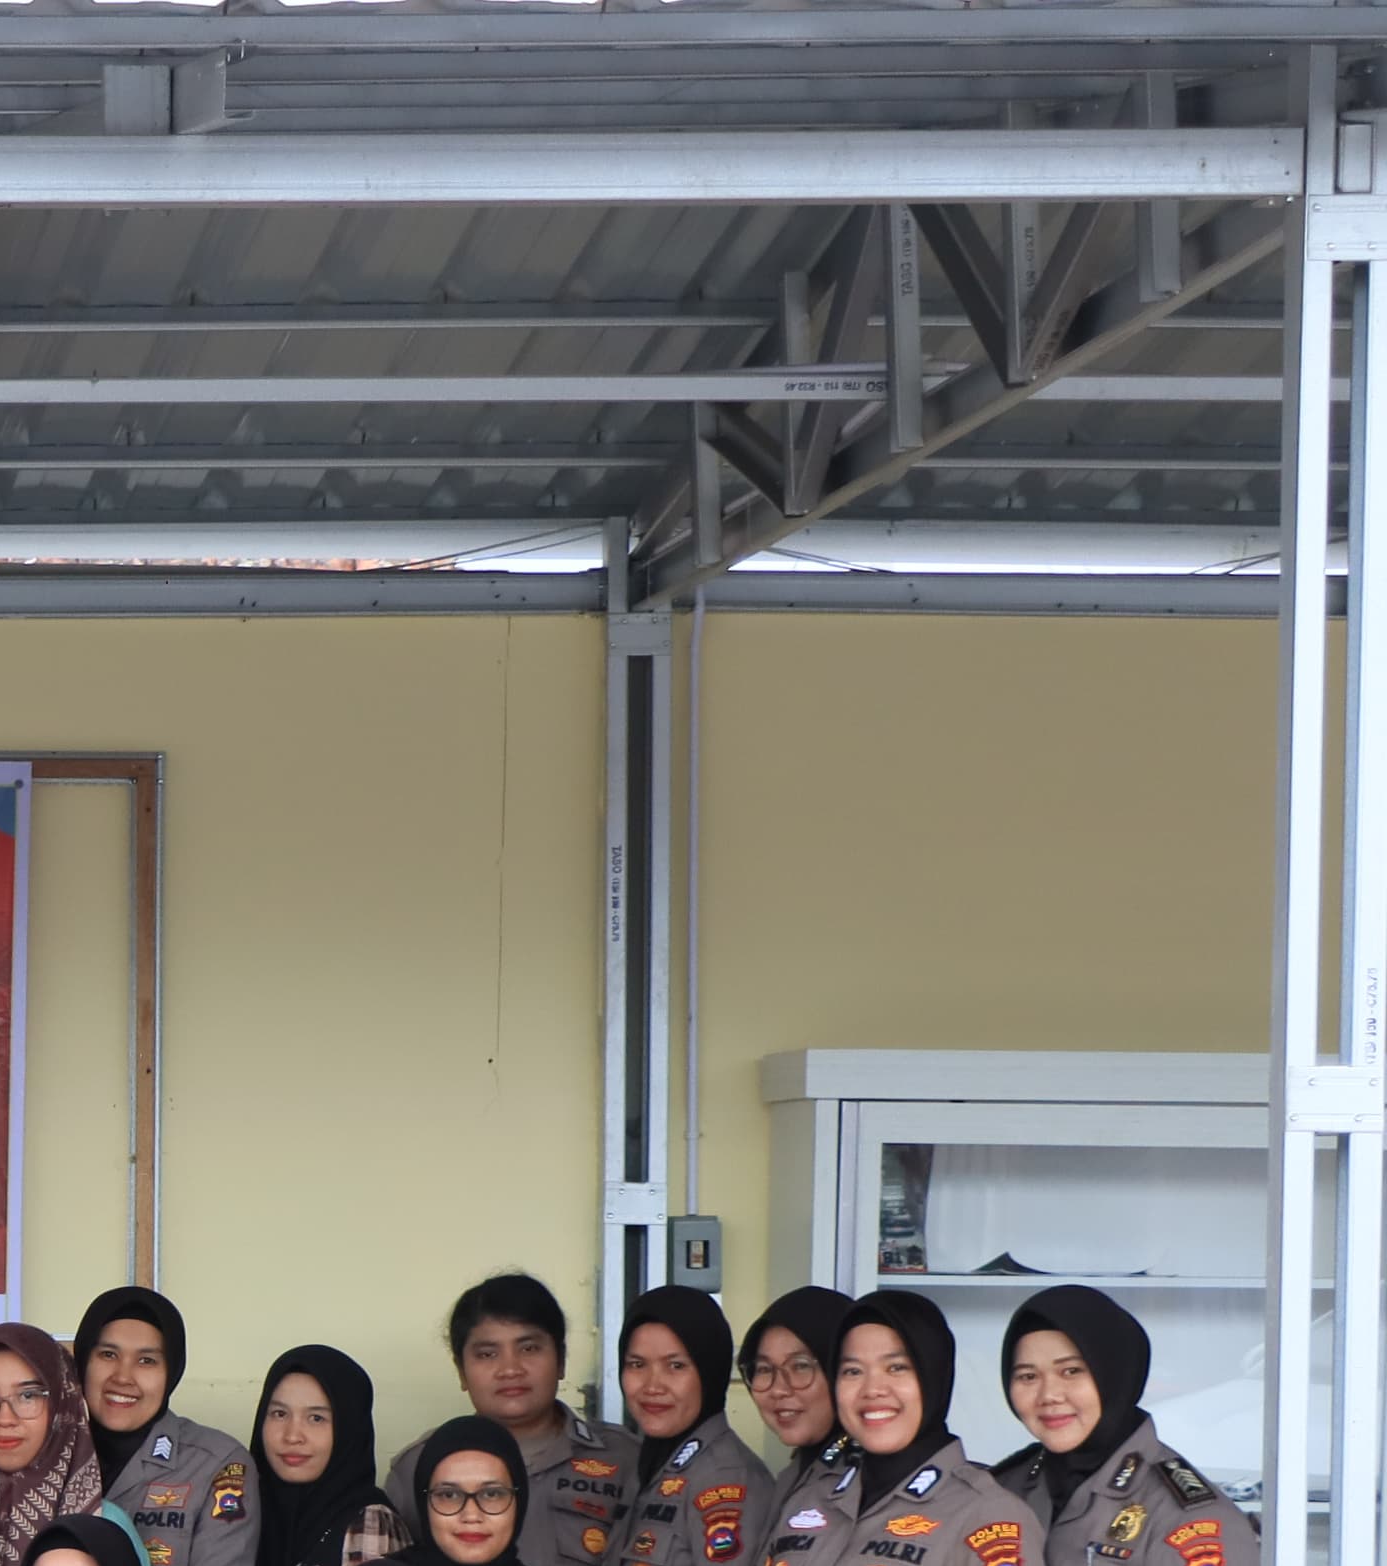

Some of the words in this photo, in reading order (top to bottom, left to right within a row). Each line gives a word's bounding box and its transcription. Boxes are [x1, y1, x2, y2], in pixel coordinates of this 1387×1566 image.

[556, 1478, 623, 1500] POLRI
[133, 1511, 185, 1529] POLRI
[860, 1540, 927, 1565] POLRI
